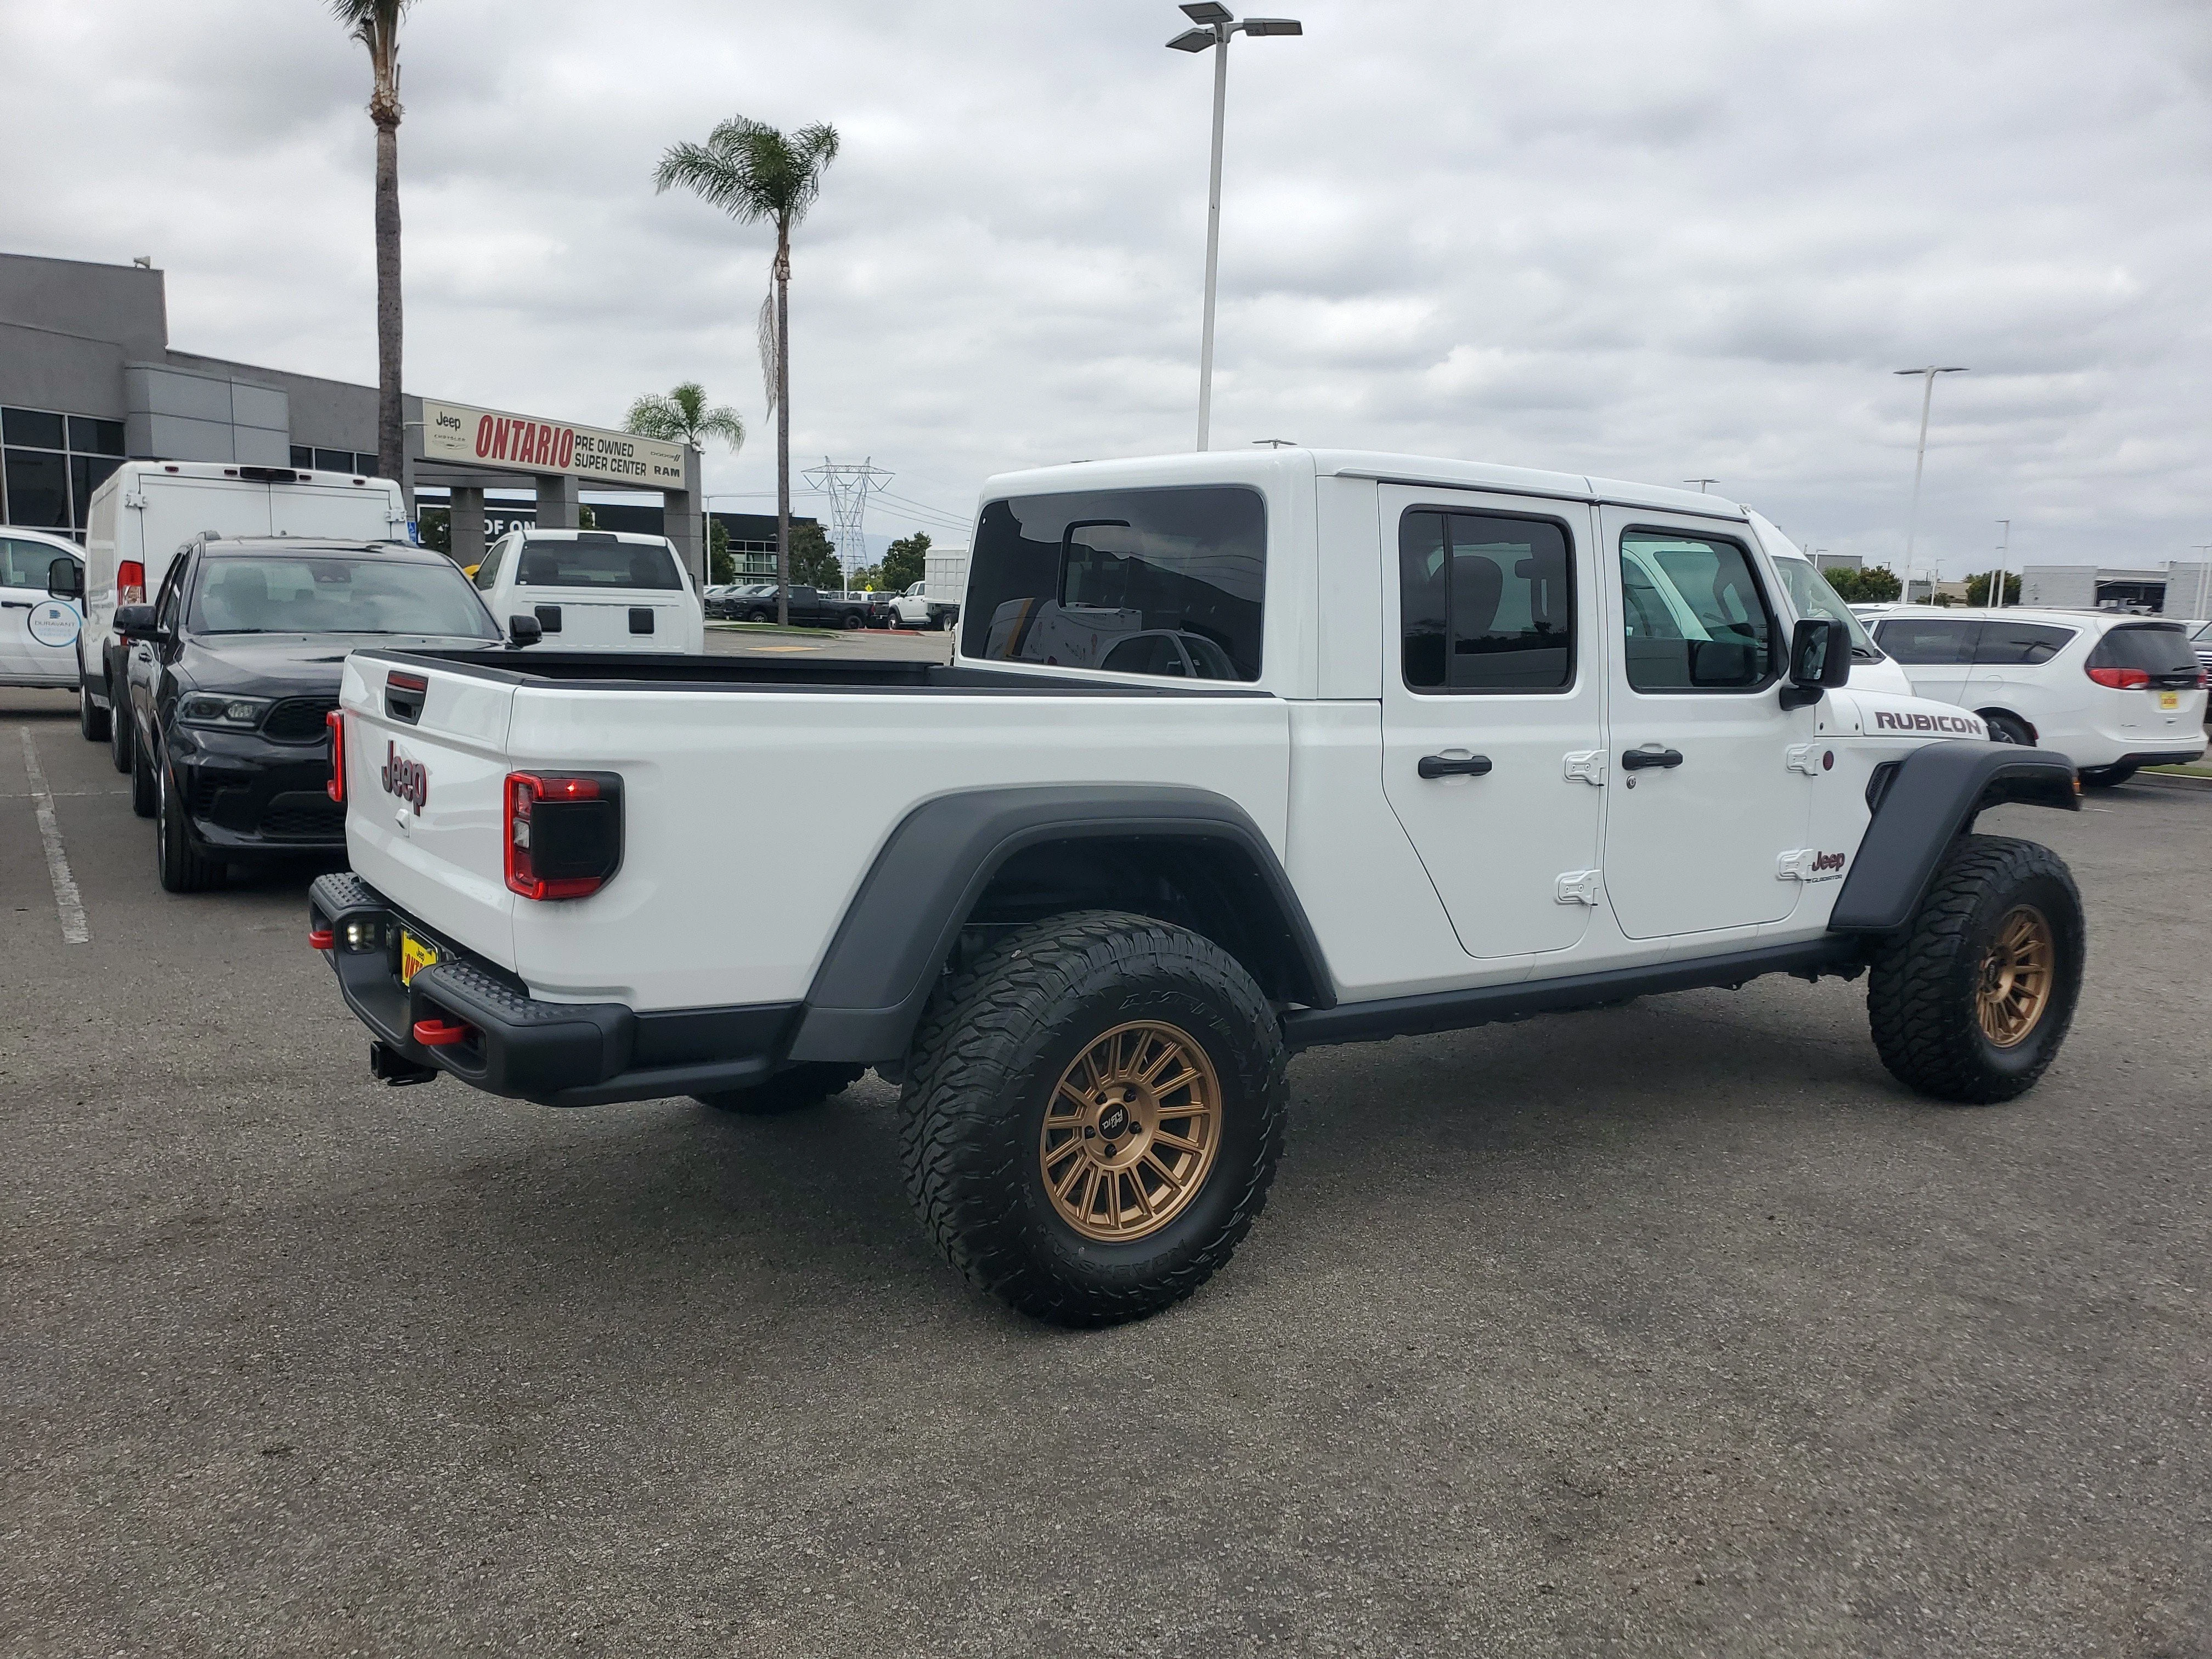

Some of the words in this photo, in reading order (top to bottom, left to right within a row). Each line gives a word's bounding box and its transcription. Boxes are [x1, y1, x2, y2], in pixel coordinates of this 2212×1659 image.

[436, 411, 461, 432] Jeep
[476, 415, 574, 468] ONTARIO
[575, 435, 595, 452] PRE
[597, 439, 634, 458] OWNED
[575, 453, 607, 471] SUPER
[610, 458, 646, 476] CENTER
[654, 466, 680, 477] RAM
[1875, 712, 1983, 735] RUBICON
[381, 740, 427, 817] Jeep
[1812, 851, 1845, 872] Jeep
